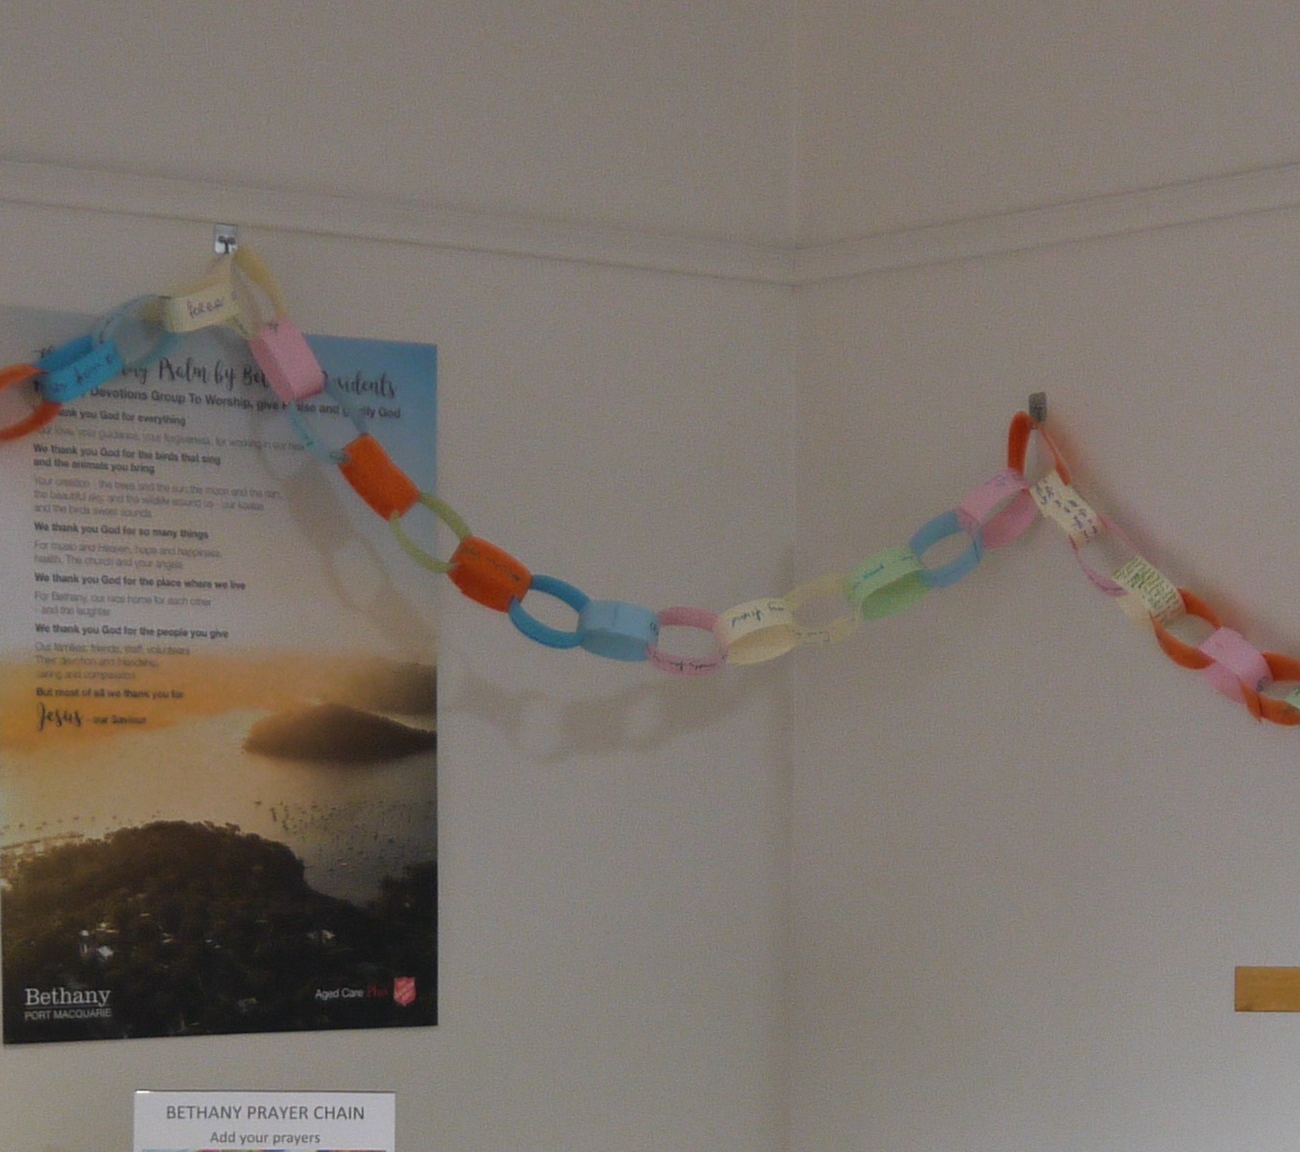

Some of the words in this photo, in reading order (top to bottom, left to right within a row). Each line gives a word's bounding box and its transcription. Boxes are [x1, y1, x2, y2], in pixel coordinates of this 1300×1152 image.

[213, 360, 235, 391] by
[150, 390, 186, 405] Group
[188, 392, 202, 405] To
[256, 401, 278, 413] give
[318, 404, 340, 415] and
[378, 408, 401, 419] God
[80, 412, 97, 422] you
[100, 411, 120, 421] God
[122, 412, 135, 422] for
[138, 414, 186, 426] everything
[33, 443, 48, 454] We
[51, 445, 78, 456] thank
[80, 448, 98, 459] you
[100, 448, 120, 458] God
[122, 449, 135, 459] for
[138, 450, 152, 460] the
[155, 451, 179, 461] birds
[181, 452, 199, 462] that
[201, 453, 221, 465] sing
[33, 457, 51, 467] and
[54, 458, 70, 468] the
[71, 459, 109, 469] animals
[111, 463, 129, 473] you
[131, 462, 155, 474] bring
[34, 522, 49, 532] We
[52, 523, 78, 533] thank
[81, 526, 98, 536] you
[100, 525, 120, 535] God
[123, 526, 136, 536] for
[139, 528, 150, 536] so
[153, 529, 177, 539] many
[180, 528, 209, 540] things
[35, 573, 49, 583] We
[52, 574, 79, 584] thank
[81, 577, 99, 587] you
[101, 576, 121, 586] God
[123, 577, 136, 586] for
[139, 577, 154, 587] the
[156, 578, 181, 589] place
[184, 579, 212, 588] where
[230, 581, 246, 590] live
[35, 624, 50, 634] We
[53, 625, 79, 635] thank
[82, 628, 99, 637] you
[101, 626, 122, 636] God
[123, 627, 137, 636] for
[139, 627, 155, 636] the
[157, 628, 188, 639] people
[190, 631, 208, 639] you
[210, 630, 229, 640] give
[36, 688, 53, 698] But
[55, 688, 80, 698] most
[82, 689, 92, 698] of
[94, 689, 105, 698] all
[107, 691, 121, 699] we
[123, 689, 150, 699] thank
[152, 692, 170, 701] you
[171, 690, 184, 699] for
[36, 701, 83, 732] Jesus
[93, 715, 109, 725] our
[23, 987, 112, 1008] Bethany
[315, 988, 341, 1001] Aged
[341, 987, 364, 998] Care
[24, 1009, 52, 1020] PORT
[52, 1008, 114, 1020] MACQUARIE
[166, 1105, 242, 1119] BETHANY
[247, 1105, 308, 1119] PRAYER
[313, 1105, 365, 1120] CHAIN
[210, 1131, 236, 1144] Add
[239, 1133, 270, 1145] your
[272, 1132, 321, 1146] prayers
